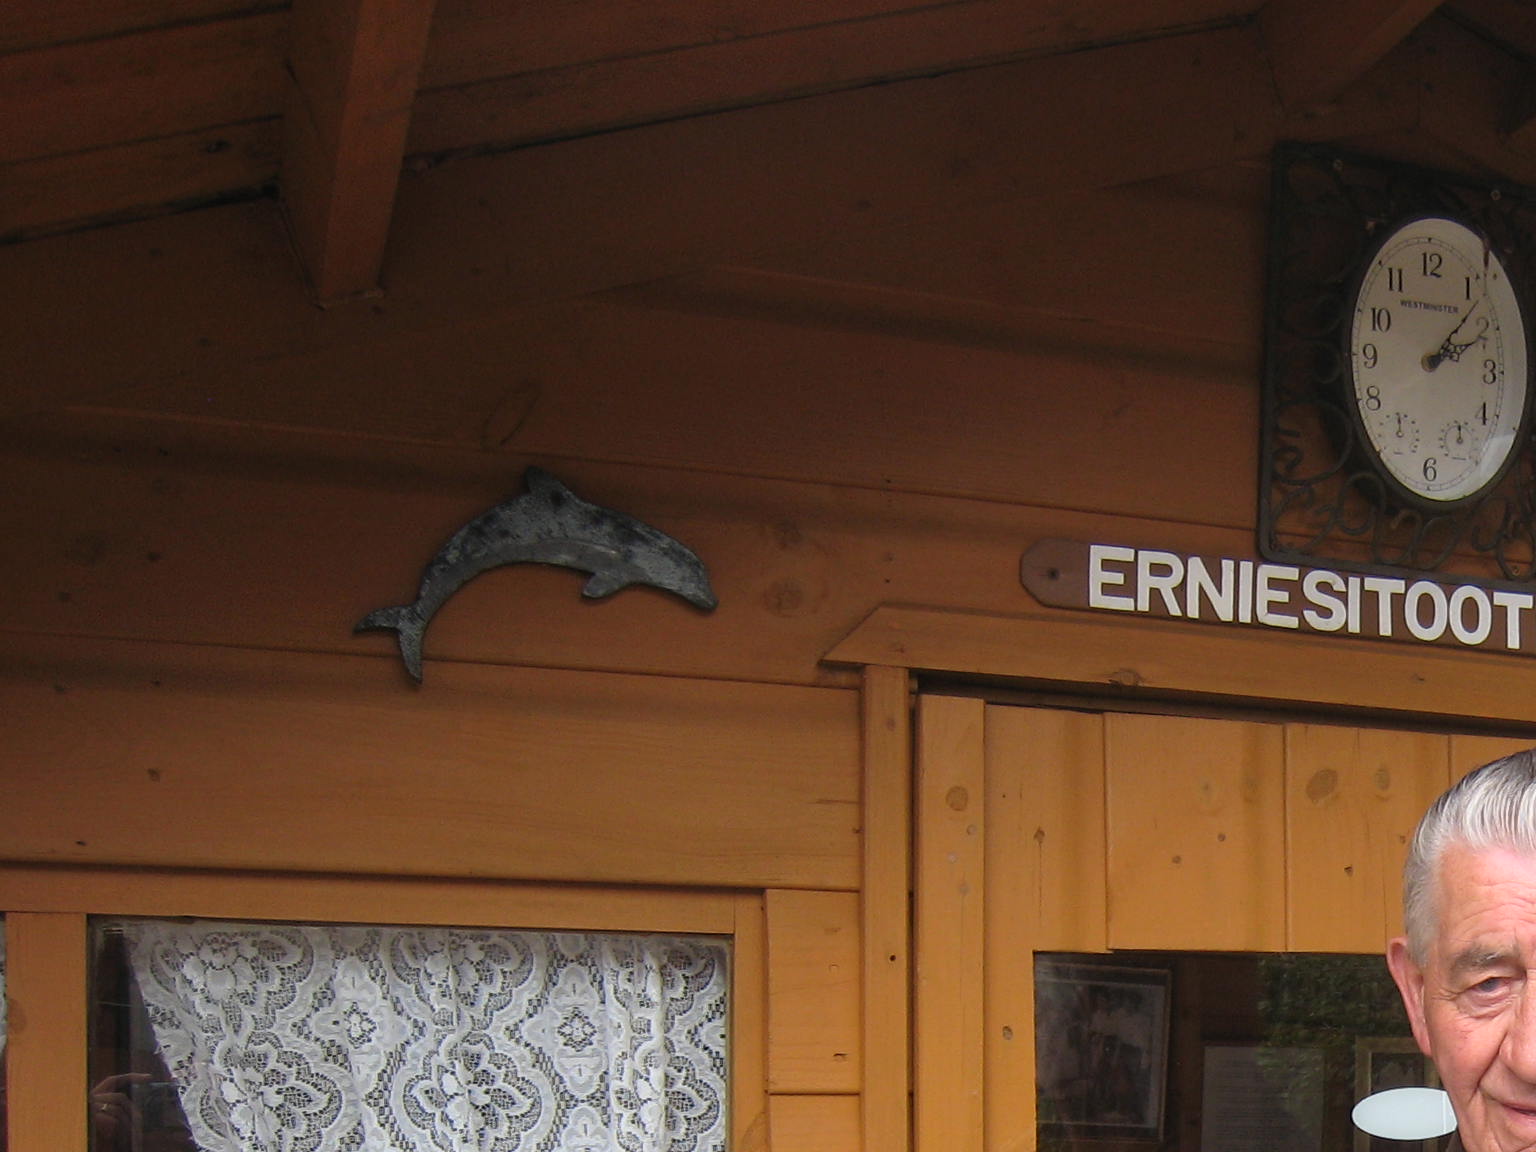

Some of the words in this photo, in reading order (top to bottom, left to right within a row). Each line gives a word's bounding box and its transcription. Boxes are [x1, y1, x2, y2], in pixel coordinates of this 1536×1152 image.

[1421, 252, 1443, 278] 12
[1388, 267, 1404, 292] 11
[1464, 276, 1472, 300] 1
[1371, 307, 1391, 332] 10
[1400, 300, 1459, 314] WESTMINSTER
[1475, 316, 1490, 341] 2
[1362, 343, 1378, 369] 9
[1482, 359, 1497, 384] 3
[1366, 385, 1381, 411] 8
[1475, 402, 1488, 426] 4
[1423, 457, 1437, 482] 6
